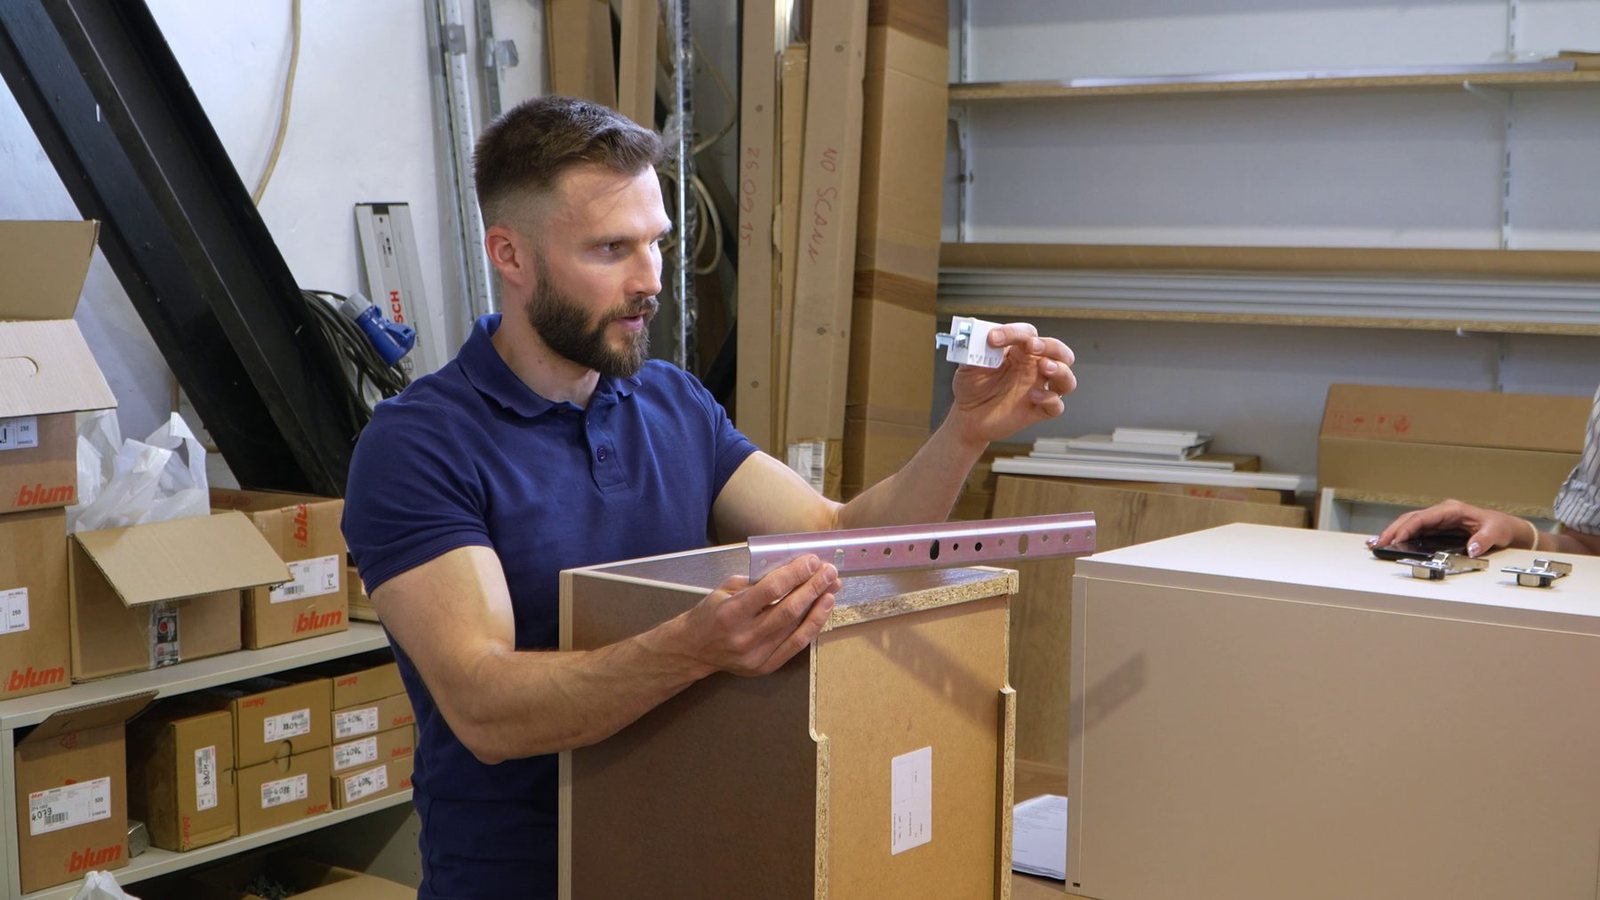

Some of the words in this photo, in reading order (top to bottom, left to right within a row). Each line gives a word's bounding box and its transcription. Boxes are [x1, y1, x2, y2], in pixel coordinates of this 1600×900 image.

[745, 147, 760, 169] 26
[820, 147, 838, 173] NO
[807, 186, 838, 265] SCANN
[390, 291, 404, 323] SCH
[15, 483, 75, 507] blum
[292, 503, 308, 544] blu
[292, 610, 343, 634] blum
[6, 665, 65, 692] blum
[65, 844, 123, 874] blum
